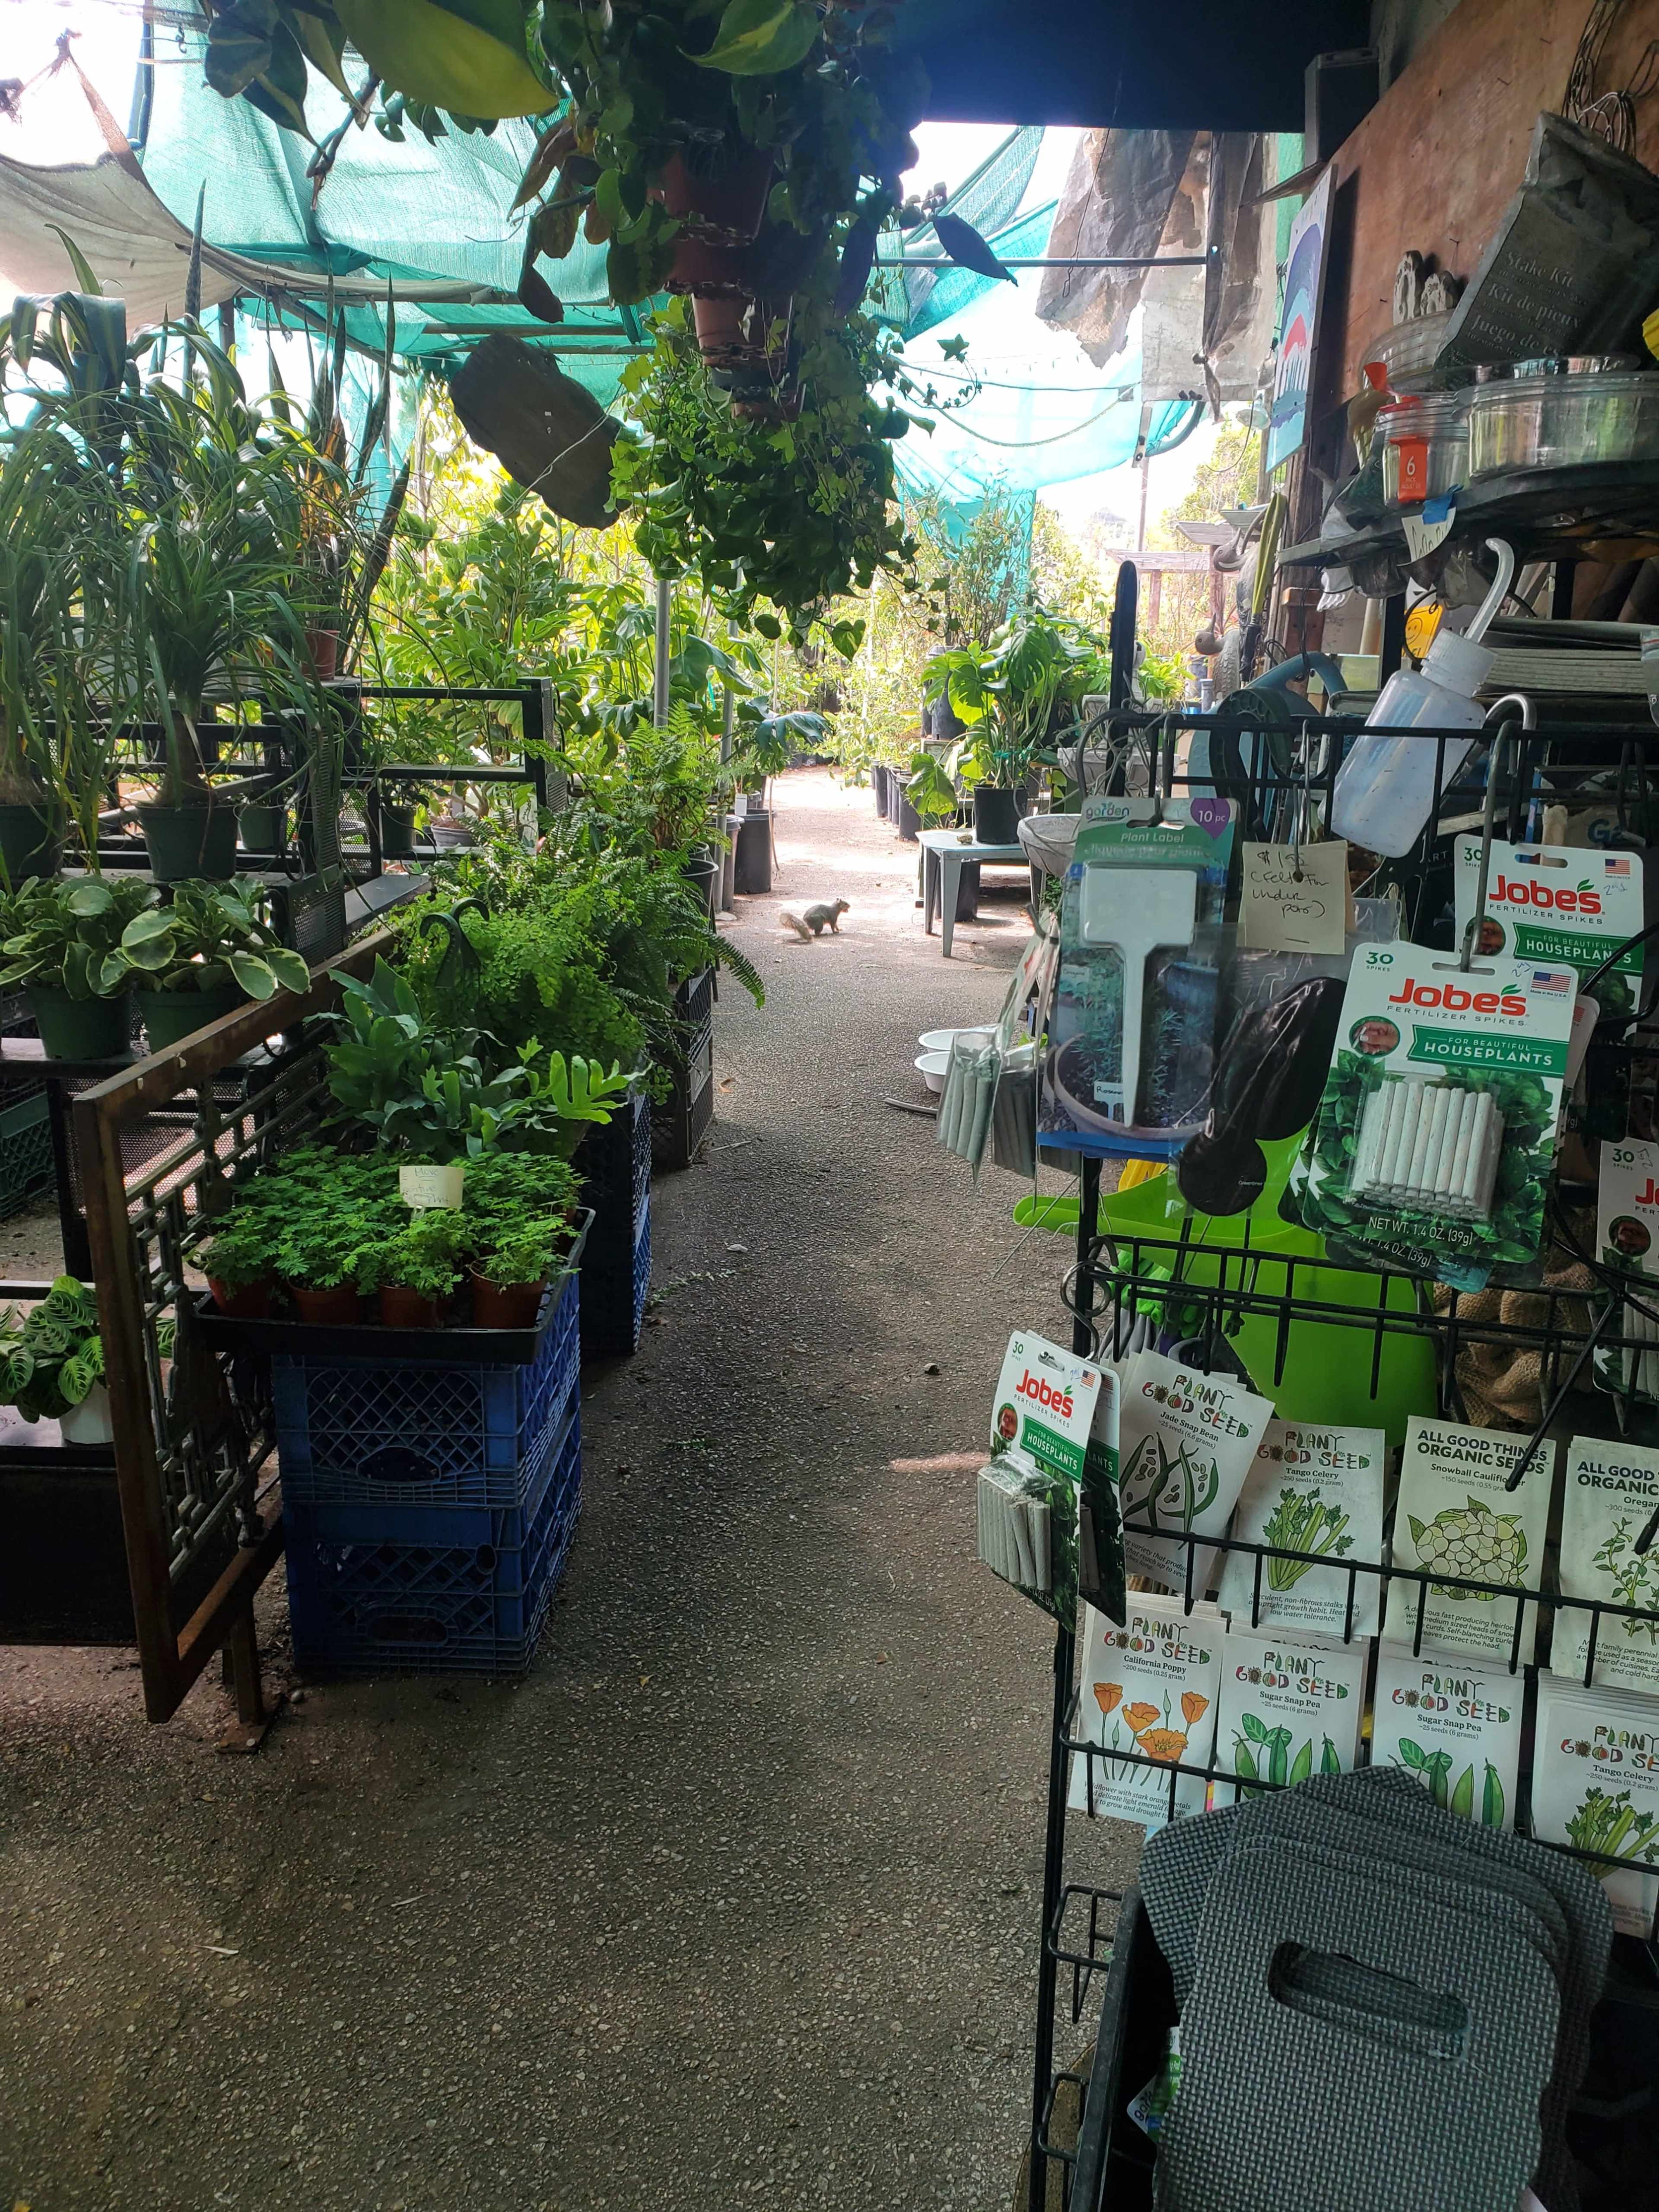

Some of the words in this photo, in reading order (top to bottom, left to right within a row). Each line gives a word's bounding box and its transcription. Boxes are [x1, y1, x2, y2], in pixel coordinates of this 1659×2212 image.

[1508, 251, 1546, 277] Stake
[1550, 267, 1573, 287] Kit
[1488, 283, 1513, 304] Kit
[1517, 295, 1534, 311] de
[1471, 314, 1516, 343] Juego
[1519, 334, 1539, 349] de
[1407, 455, 1415, 475] 6
[1086, 805, 1130, 819] garden
[1198, 810, 1212, 822] 10
[1121, 833, 1149, 842] Plant
[1153, 833, 1184, 843] Label
[1489, 904, 1553, 918] FERTILIZER
[1560, 915, 1603, 925] SPIKES
[1526, 940, 1632, 963] HOUSEPLANS
[1543, 935, 1558, 943] FOR
[1563, 938, 1612, 949] BEAUTIFUL
[1366, 952, 1394, 965] 30
[1387, 1005, 1467, 1020] FERTILIZER
[1475, 1016, 1526, 1026] SPIKES
[1424, 1042, 1553, 1066] HOUSEPLANTS
[1473, 1040, 1531, 1051] BEAUTIFUL
[1612, 1148, 1634, 1163] 30
[1369, 1216, 1390, 1230] NET
[1392, 1220, 1409, 1234] WT.
[1413, 1224, 1426, 1236] 1.4
[1429, 1227, 1445, 1240] OZ.
[1448, 1229, 1473, 1247] (39g)
[1392, 1243, 1405, 1257] OZ.
[1408, 1246, 1432, 1268] (39g)
[1012, 1341, 1023, 1354] 30
[1173, 1375, 1234, 1410] PLANT
[1014, 1394, 1048, 1414] FERTILIZER
[1050, 1413, 1070, 1428] SPIKES
[1142, 1382, 1194, 1413] GOOD
[1200, 1407, 1249, 1438] SEED
[1160, 1411, 1179, 1424] Jade
[1179, 1420, 1198, 1433] Snap
[1199, 1430, 1219, 1442] Bean
[1038, 1430, 1047, 1439] FOR
[1047, 1434, 1070, 1453] BEAUTIFUL
[1169, 1425, 1184, 1434] seeds
[1185, 1432, 1195, 1440] (6.6
[1195, 1436, 1216, 1449] grams)
[1286, 1431, 1346, 1451] PLANT
[1417, 1430, 1444, 1443] ALL
[1447, 1435, 1490, 1451] GOOD
[1027, 1432, 1078, 1470] HOUSEPLANTS
[1257, 1444, 1311, 1464] GOOD
[1319, 1450, 1370, 1469] SEED
[1417, 1442, 1493, 1465] ORGANIC
[1495, 1456, 1545, 1475] SEDS
[1286, 1468, 1311, 1477] Tango
[1313, 1469, 1339, 1480] Celery
[1431, 1463, 1471, 1477] Snowball
[1473, 1471, 1526, 1487] Caulifloer
[1577, 1461, 1605, 1475] ALL
[1608, 1465, 1655, 1481] GOOD
[1457, 1478, 1475, 1487] seeds
[1476, 1481, 1492, 1490] (0.55
[1578, 1474, 1659, 1496] ORGANIC
[1127, 1547, 1140, 1556] that
[1140, 1553, 1156, 1565] reach
[1131, 1542, 1153, 1556] variety
[1153, 1552, 1166, 1562] that
[1284, 1597, 1322, 1606] non-fibrous
[1284, 1604, 1308, 1612] growth
[1309, 1605, 1327, 1615] habit.
[1303, 1613, 1336, 1622] tolerance.
[1441, 1611, 1454, 1620] fast
[1456, 1615, 1489, 1627] producing
[1132, 1617, 1189, 1642] PLANT
[1447, 1627, 1494, 1642] Self-blanching
[1468, 1624, 1488, 1634] heads
[1104, 1631, 1155, 1653] GOOD
[1161, 1642, 1210, 1664] SEED
[1443, 1634, 1469, 1643] protect
[1482, 1641, 1500, 1649] head.
[1601, 1642, 1623, 1652] family
[1624, 1648, 1658, 1658] perennial
[1124, 1655, 1161, 1669] California
[1163, 1662, 1187, 1674] Poppy
[1154, 1669, 1168, 1678] (0.25
[1264, 1651, 1325, 1677] PLANT
[1620, 1661, 1649, 1672] cuisines.
[1625, 1669, 1640, 1677] cold
[1236, 1665, 1289, 1688] GOOD
[1296, 1676, 1348, 1699] SEED
[1422, 1673, 1485, 1700] PLANT
[1259, 1691, 1283, 1702] Sugar
[1284, 1696, 1305, 1707] Snap
[1306, 1700, 1321, 1708] Pea
[1392, 1688, 1449, 1712] GOOD
[1456, 1699, 1510, 1723] SEED
[1417, 1714, 1442, 1725] Sugar
[1443, 1719, 1465, 1730] Snap
[1466, 1723, 1482, 1732] Pea
[1431, 1726, 1448, 1735] seeds
[1594, 1726, 1659, 1754] PLANT
[1560, 1738, 1623, 1763] GOOD
[1593, 1764, 1621, 1776] Tango
[1624, 1771, 1654, 1783] Celery
[1118, 1789, 1131, 1797] with
[1637, 1783, 1658, 1792] gram)
[1098, 1790, 1122, 1802] delicate
[1123, 1796, 1137, 1805] light
[1138, 1801, 1163, 1811] emerald
[1106, 1801, 1122, 1809] grow
[1136, 1808, 1161, 1818] drought
